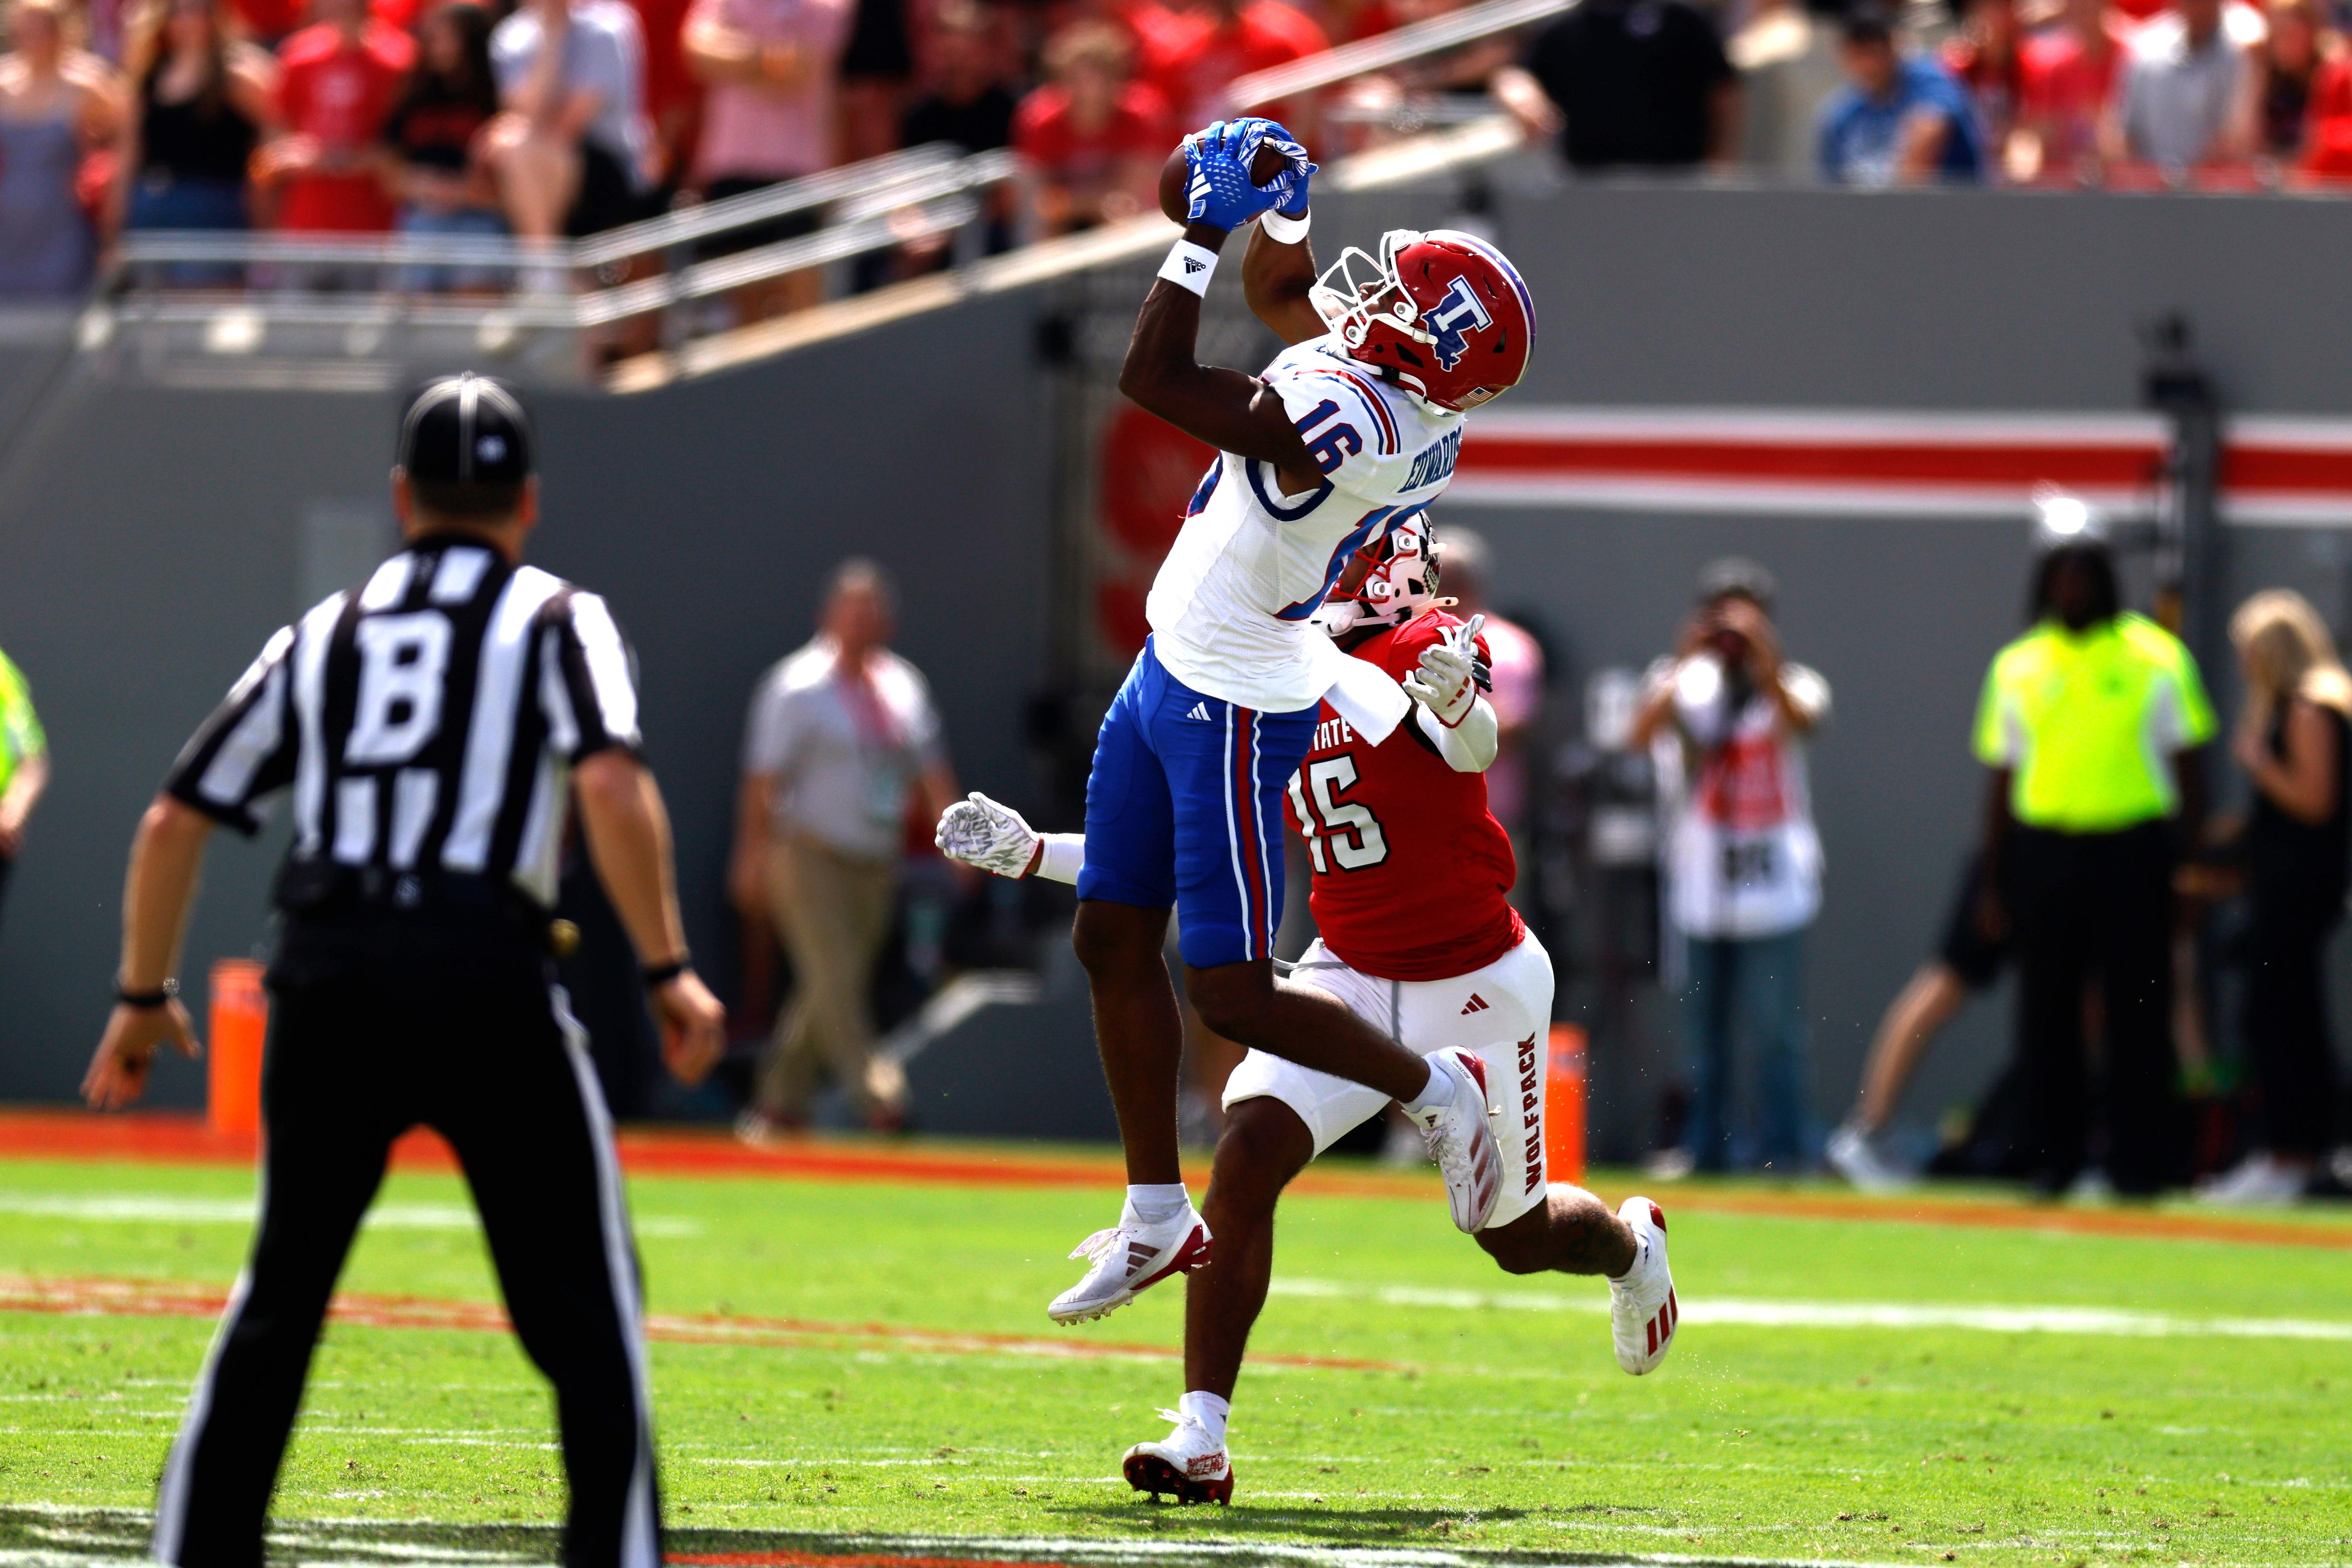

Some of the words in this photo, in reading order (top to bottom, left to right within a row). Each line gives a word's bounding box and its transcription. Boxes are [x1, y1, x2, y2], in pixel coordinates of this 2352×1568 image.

[1183, 256, 1206, 269] adidas
[1295, 399, 1363, 475] 16
[343, 608, 455, 765] B
[1311, 716, 1353, 751] TATE
[1287, 753, 1391, 875] 15
[1517, 1031, 1542, 1196] WOLFPACK
